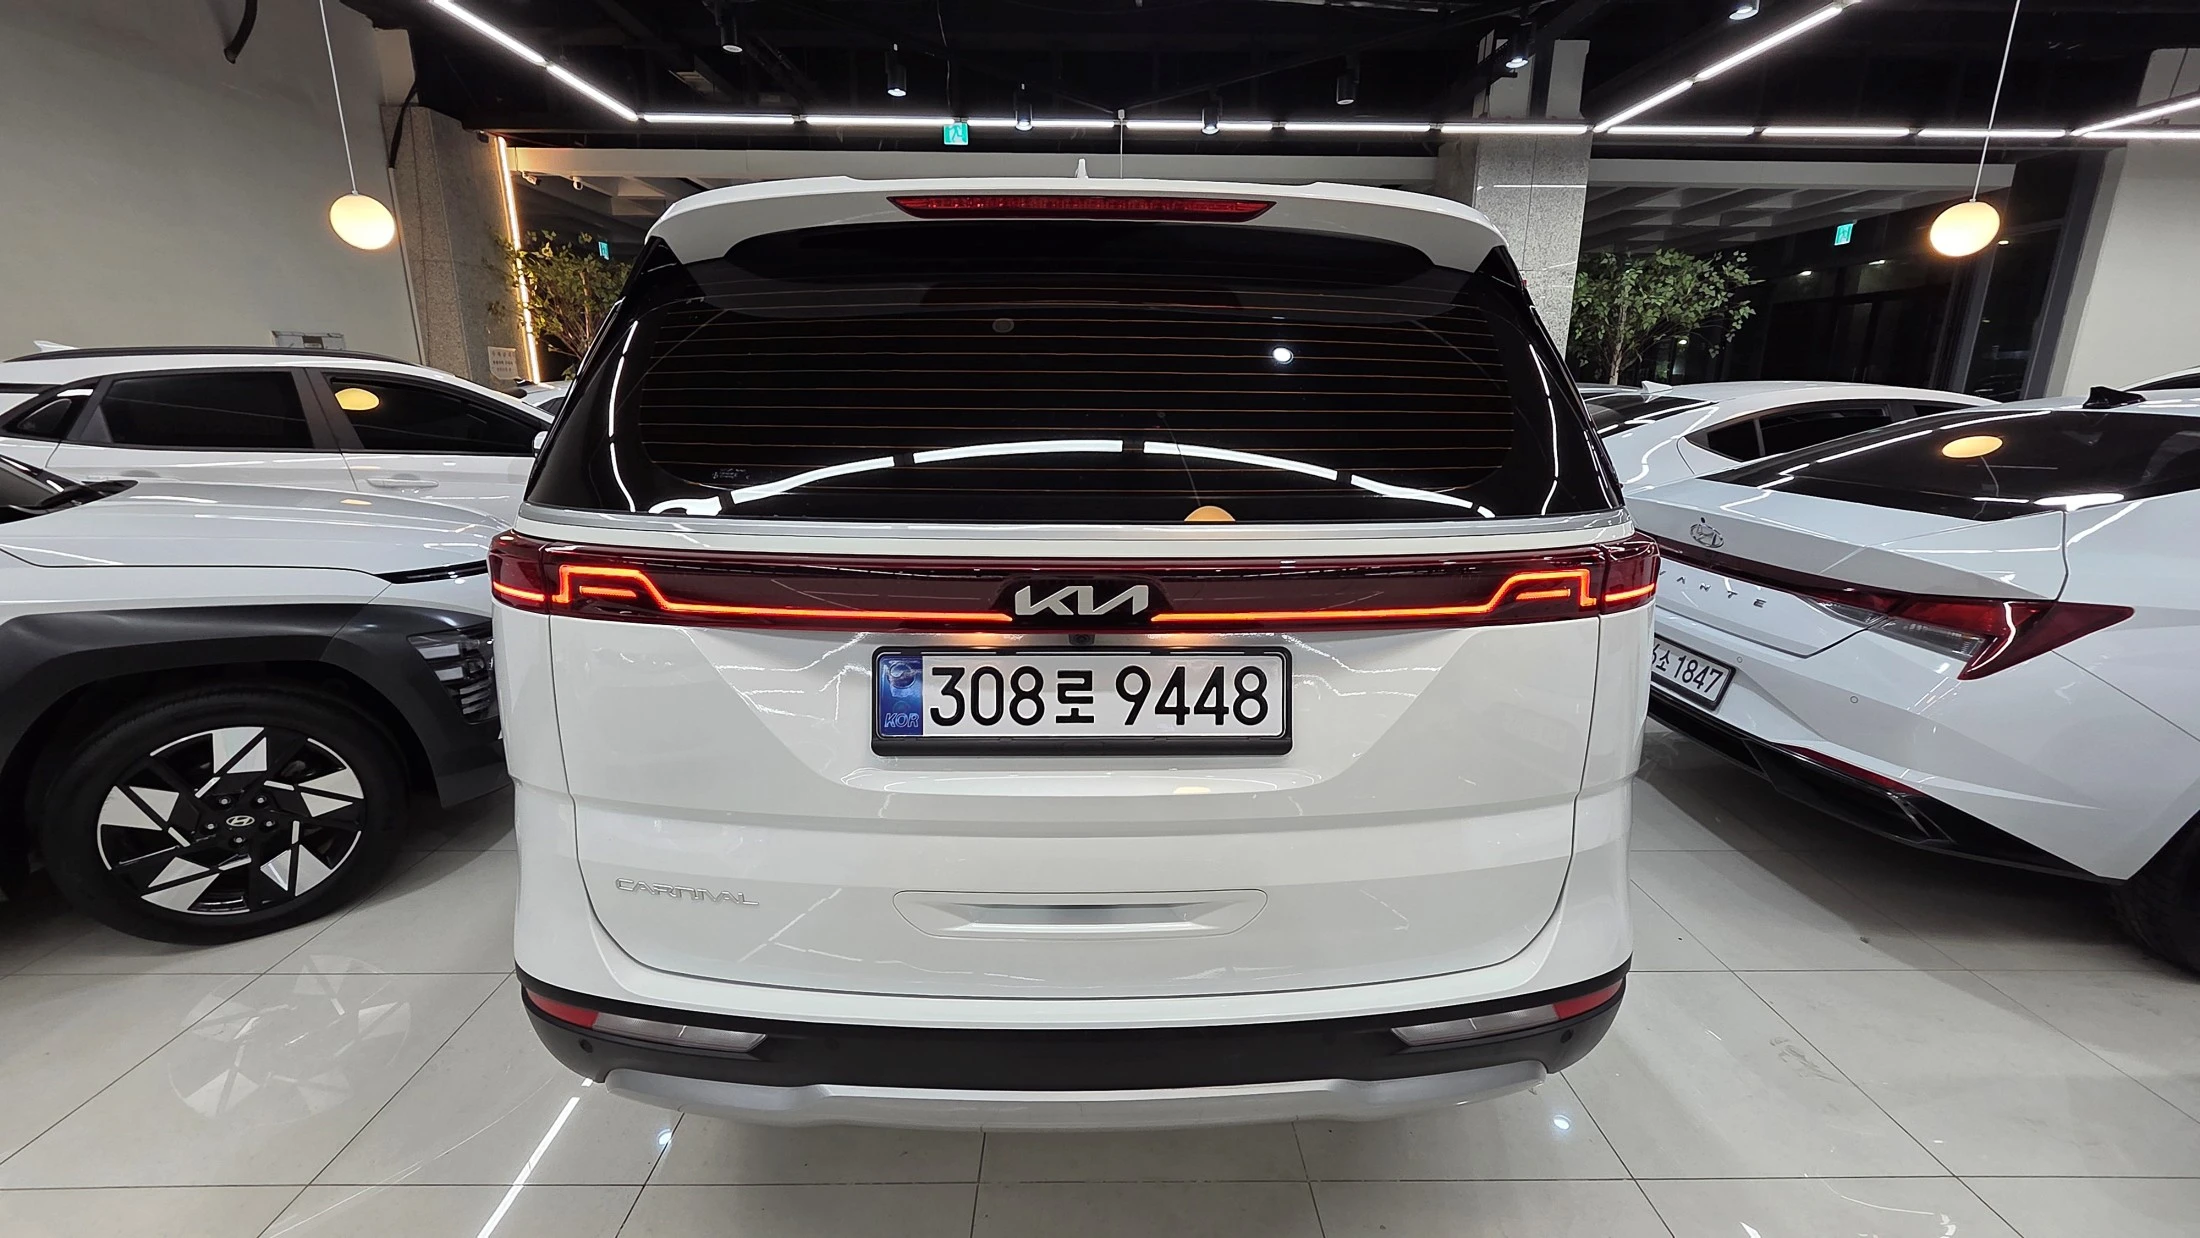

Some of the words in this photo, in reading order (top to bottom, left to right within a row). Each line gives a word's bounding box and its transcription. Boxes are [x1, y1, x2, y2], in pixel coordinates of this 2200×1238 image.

[1014, 585, 1149, 616] KIA
[1674, 655, 1724, 693] 1847
[929, 665, 1095, 726] 308로
[1115, 665, 1269, 726] 9448
[884, 712, 920, 728] KOR
[615, 877, 760, 907] CARNIVAL
